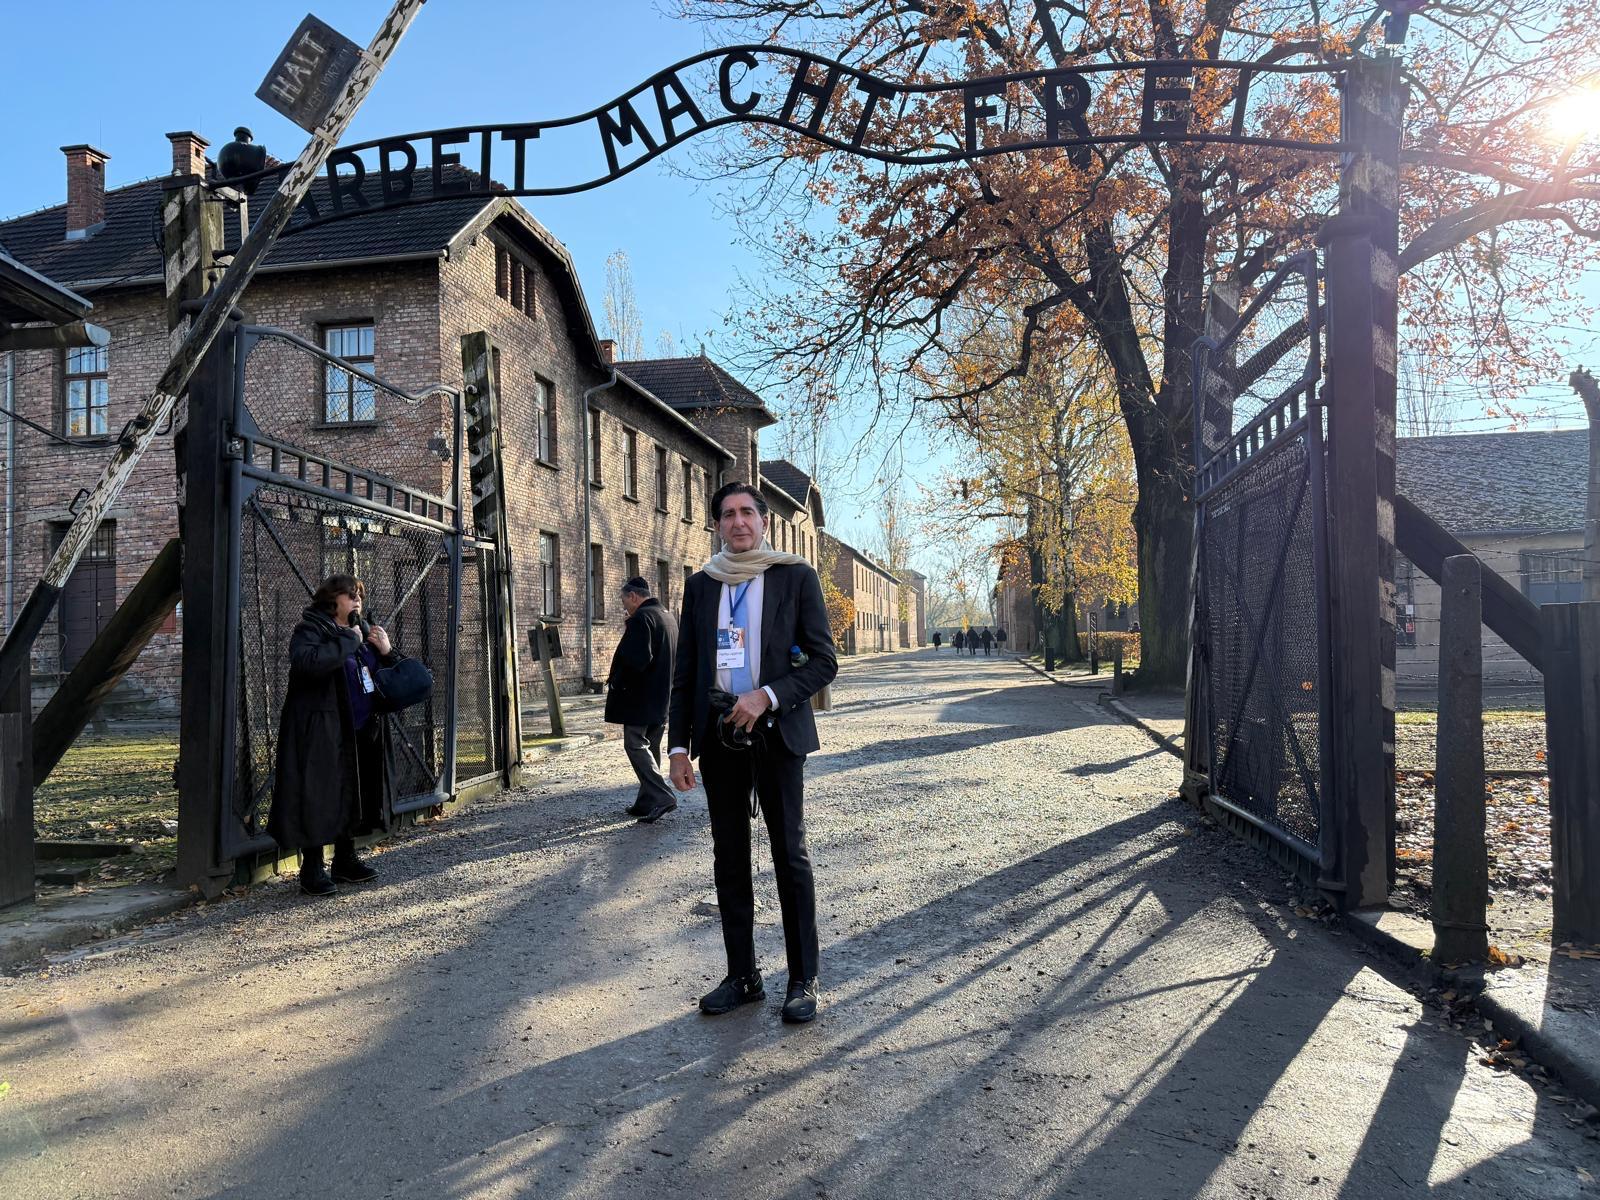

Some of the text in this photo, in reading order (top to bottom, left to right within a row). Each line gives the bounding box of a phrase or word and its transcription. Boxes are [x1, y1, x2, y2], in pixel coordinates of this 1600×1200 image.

[269, 29, 326, 104] HALT
[597, 50, 898, 176] MACHT
[963, 66, 1252, 152] FREI
